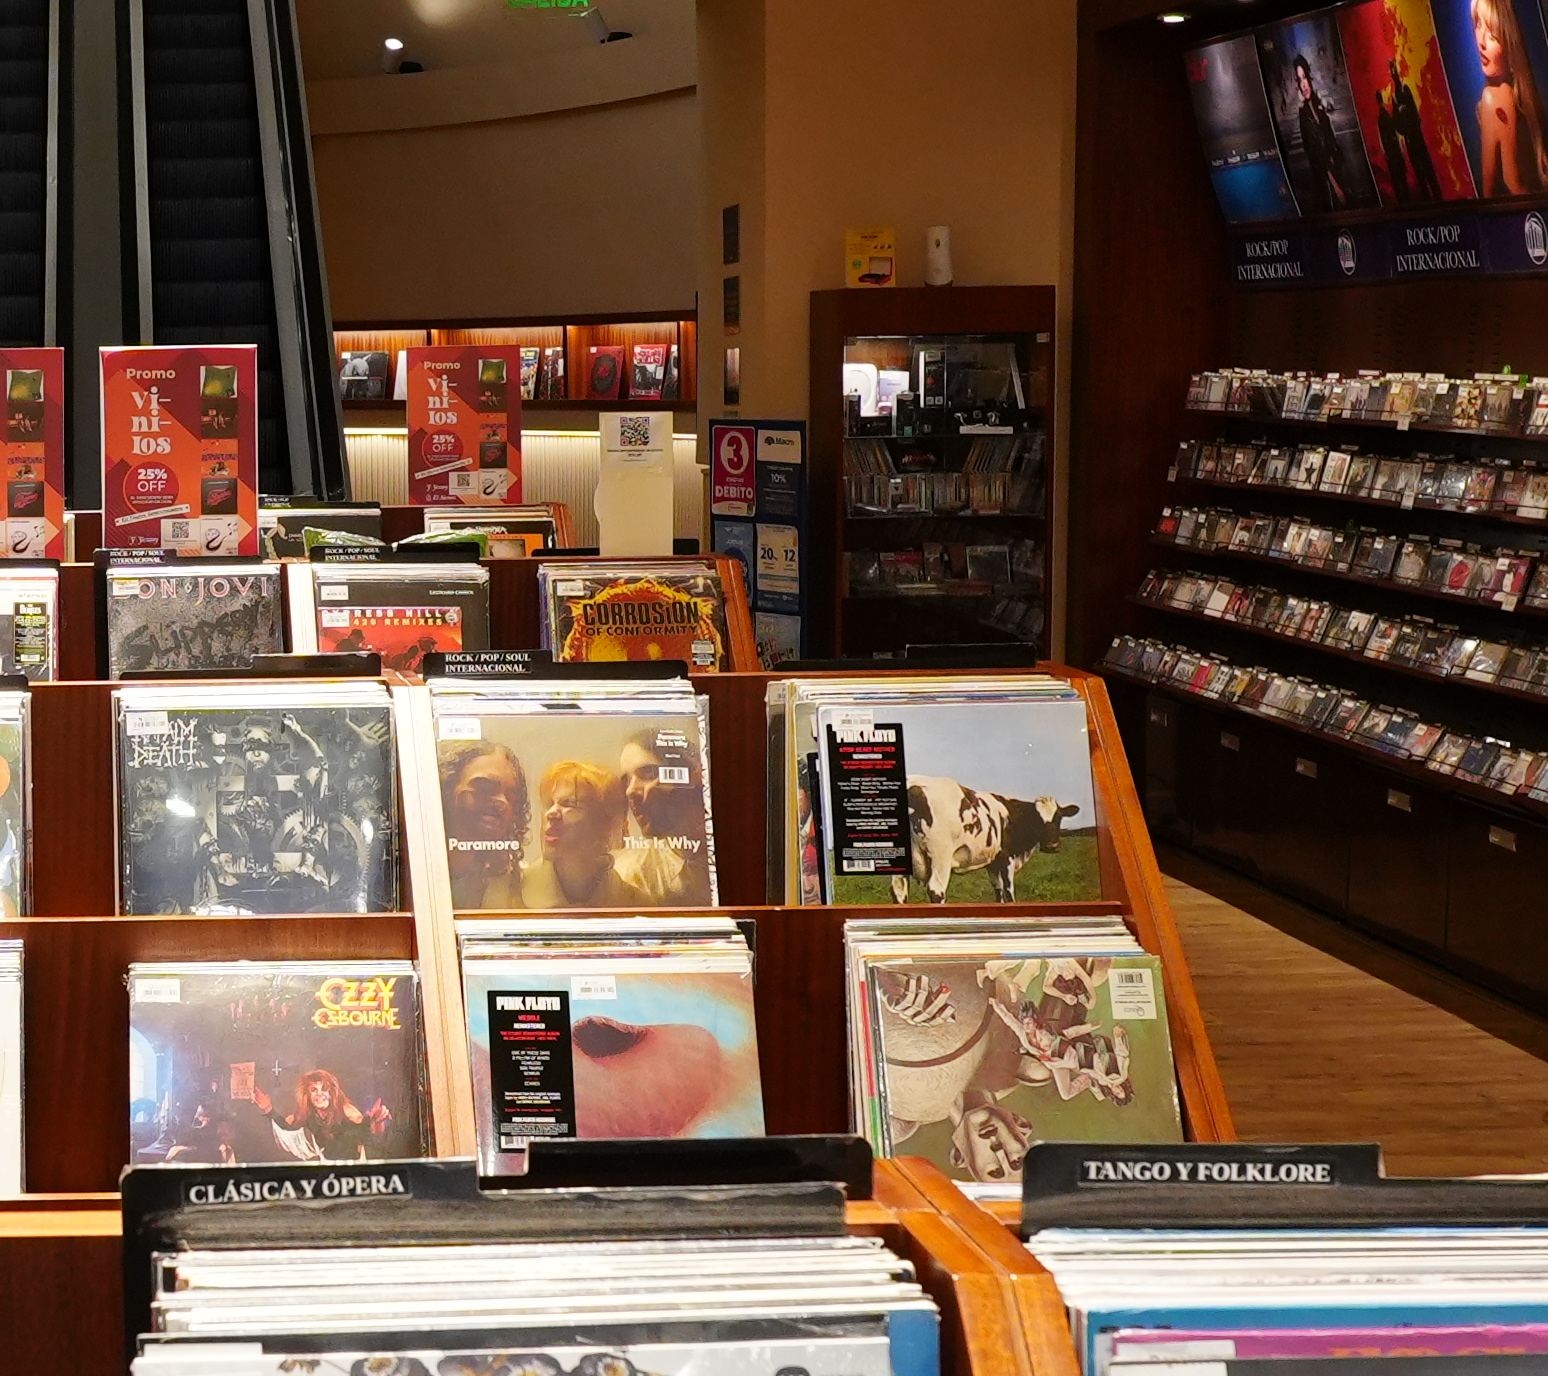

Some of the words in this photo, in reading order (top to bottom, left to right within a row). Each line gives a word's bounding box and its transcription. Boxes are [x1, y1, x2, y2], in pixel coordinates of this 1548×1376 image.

[1406, 224, 1461, 246] ROCK/POP
[1245, 240, 1289, 259] ROCK/POP
[1396, 250, 1480, 273] INTERNACIONAL
[1237, 260, 1304, 281] INTERNACIONAL
[424, 361, 461, 370] Promo
[126, 368, 176, 380] Promo
[432, 435, 455, 443] 25%
[432, 444, 454, 452] OFF
[137, 468, 167, 480] 25%
[770, 473, 787, 484] 10%
[137, 480, 167, 492] OFF
[784, 548, 796, 563] 12
[405, 609, 443, 618] HILL
[354, 618, 377, 627] 420
[385, 618, 443, 627] REMIXES
[586, 626, 604, 637] OF
[608, 625, 700, 636] CONFORMITY
[445, 653, 473, 663] ROCK
[480, 653, 500, 663] POP
[505, 653, 532, 663] SOUL
[445, 663, 526, 674] INTERNACIONAL
[127, 741, 198, 768] DEATH
[448, 837, 520, 853] Paramore
[622, 837, 654, 851] This
[656, 837, 668, 851] Is
[670, 837, 701, 855] Why
[311, 1007, 402, 1031] OSBOURNE
[1084, 1160, 1172, 1184] TANGO
[1176, 1162, 1192, 1183] Y
[1197, 1161, 1331, 1184] FOLKLORE
[189, 1178, 296, 1203] CLÁSICA
[302, 1179, 318, 1198] Y
[322, 1172, 405, 1198] ÓPERA
